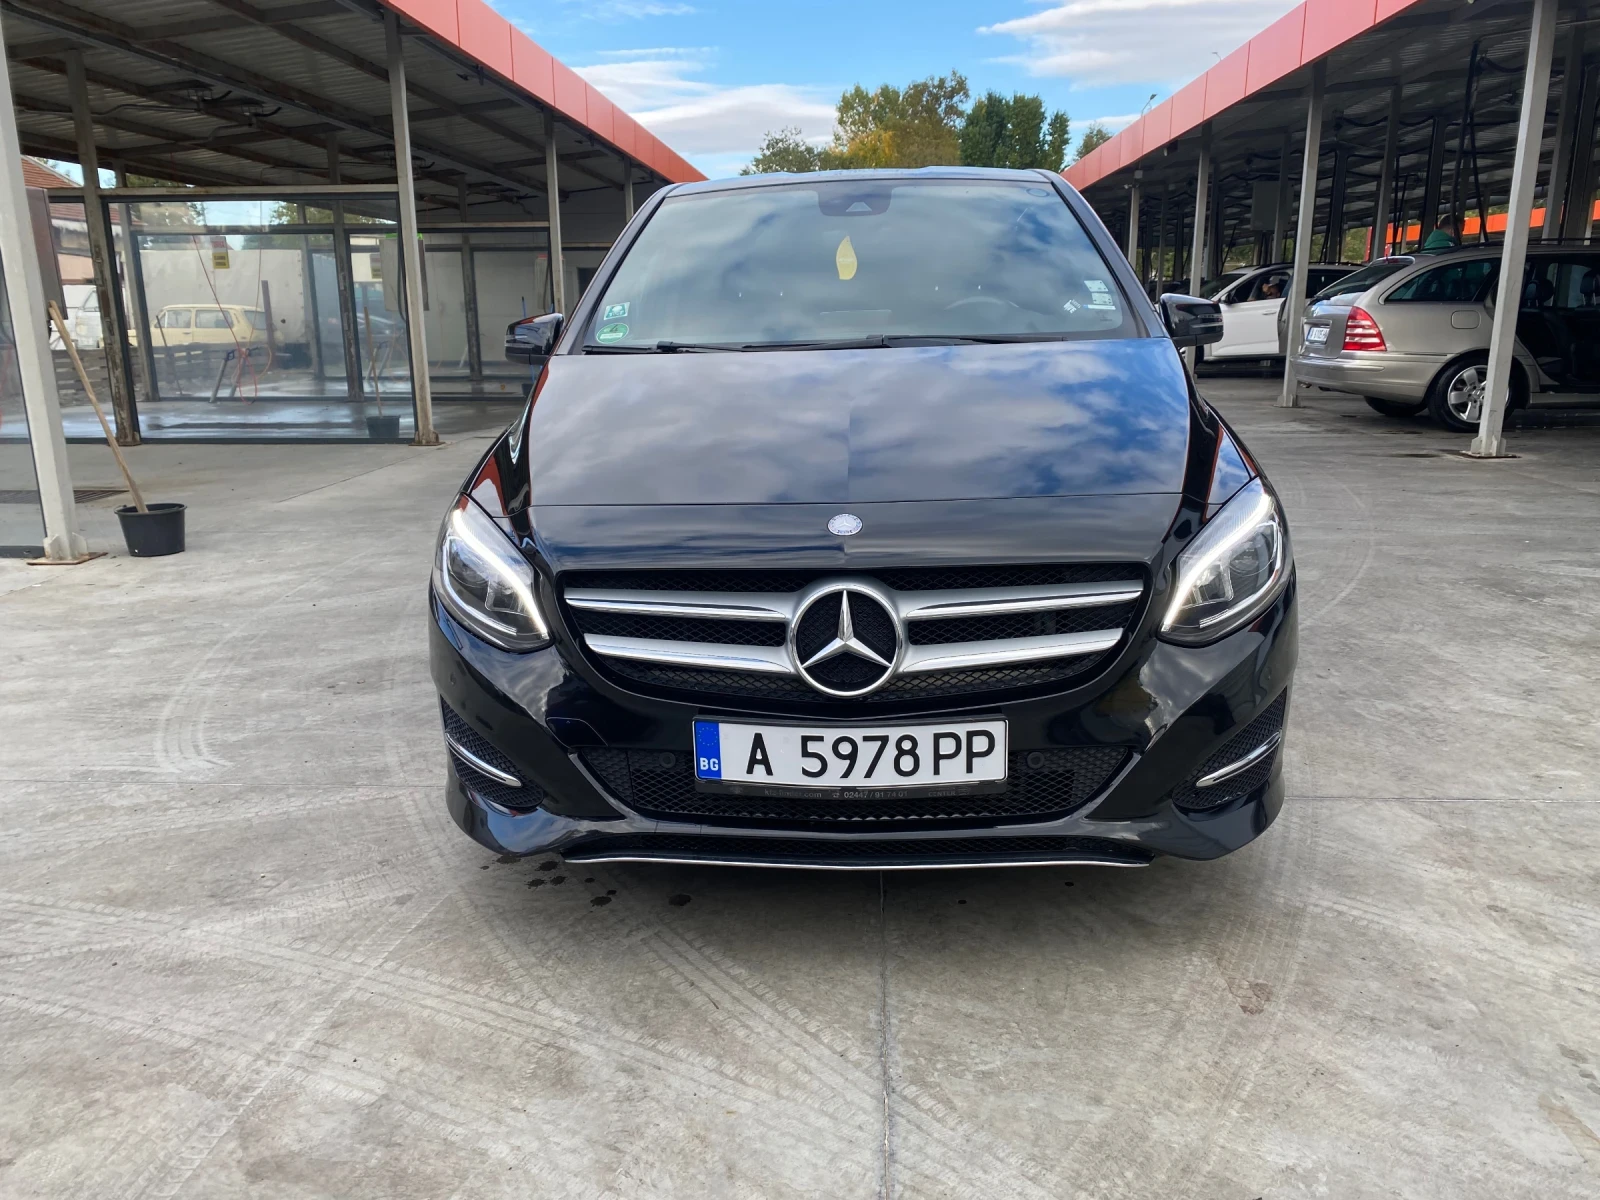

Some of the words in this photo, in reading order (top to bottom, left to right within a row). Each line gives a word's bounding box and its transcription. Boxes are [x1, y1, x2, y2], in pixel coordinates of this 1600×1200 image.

[700, 757, 719, 771] BG
[746, 732, 774, 776] A
[800, 734, 921, 778] 5978
